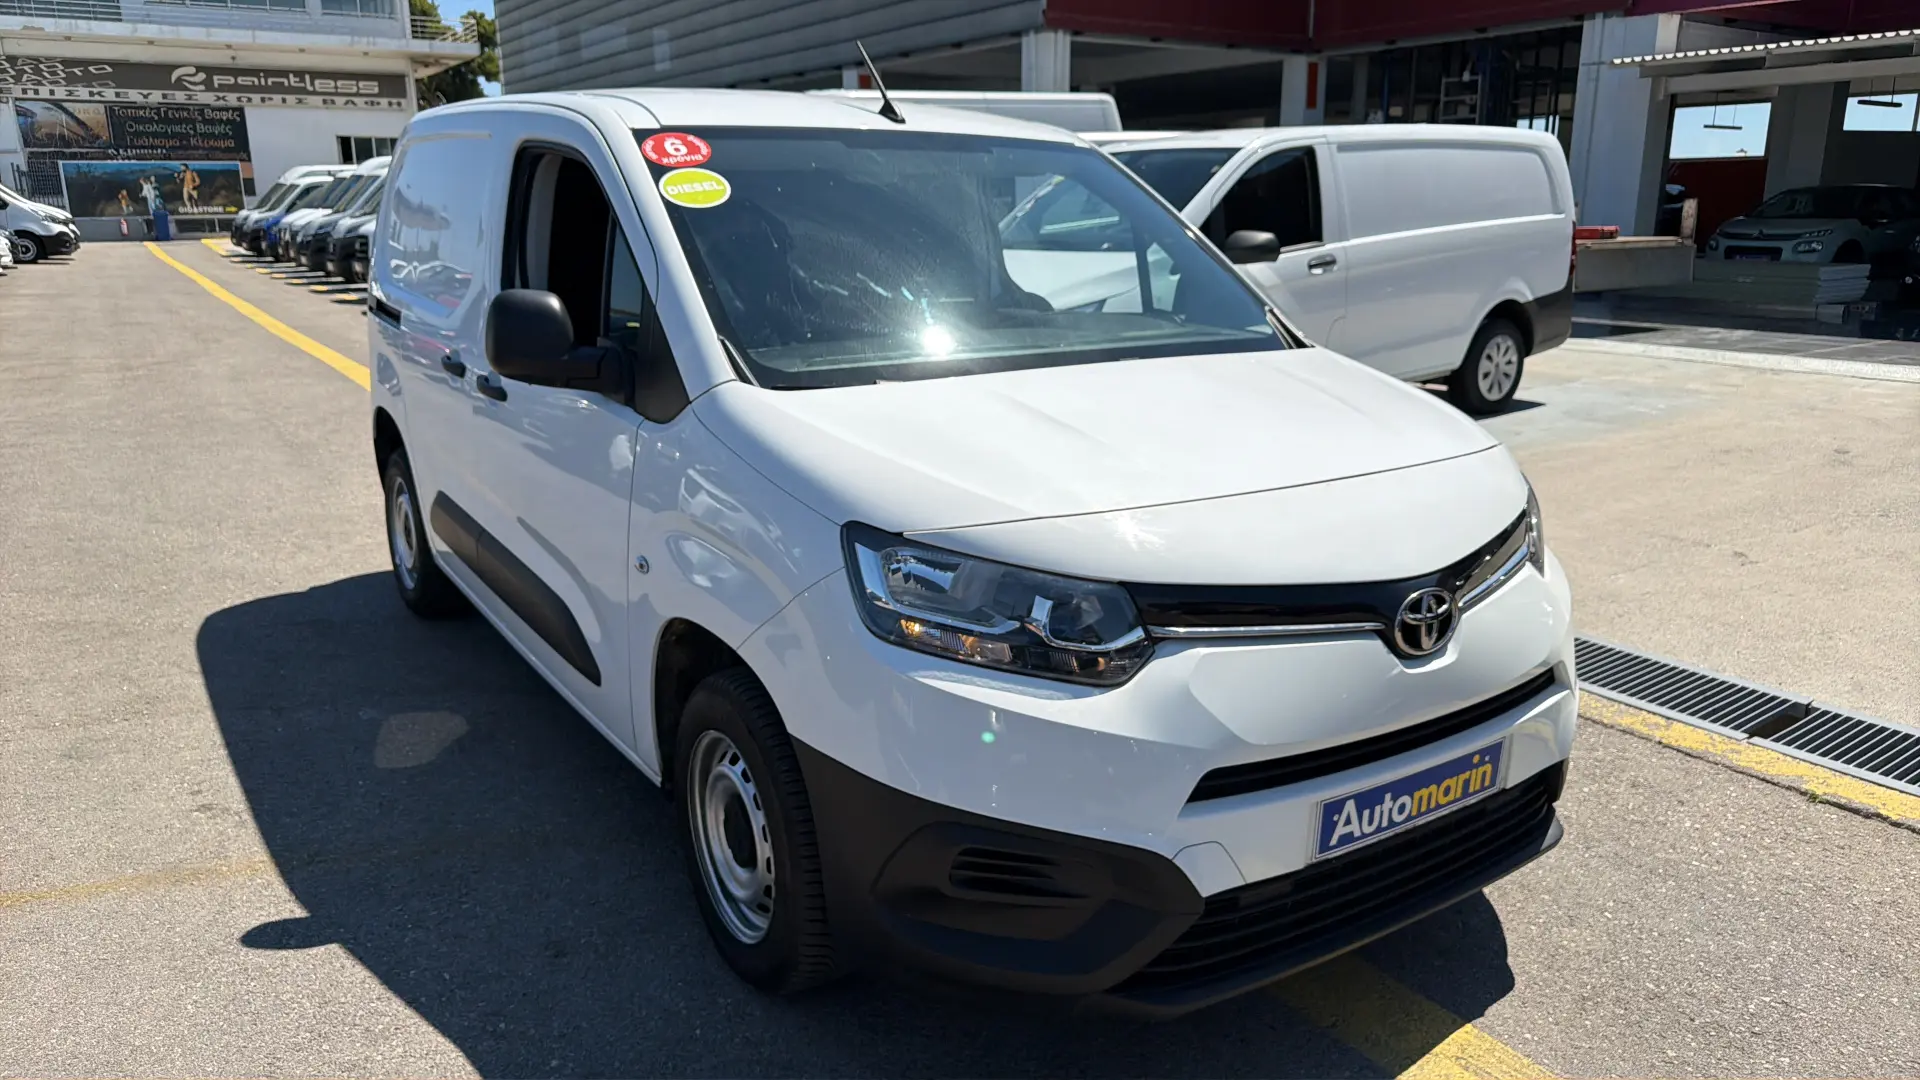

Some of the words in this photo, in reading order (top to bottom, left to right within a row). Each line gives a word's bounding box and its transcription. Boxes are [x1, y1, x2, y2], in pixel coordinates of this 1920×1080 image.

[213, 72, 379, 95] paintless
[213, 94, 310, 106] ΧΩΡΙΣ
[322, 98, 402, 108] ΒΑΦΗ
[203, 107, 241, 121] Βαφές
[664, 138, 689, 157] 6
[666, 181, 724, 196] DIESEL
[1329, 754, 1493, 847] Automarin
